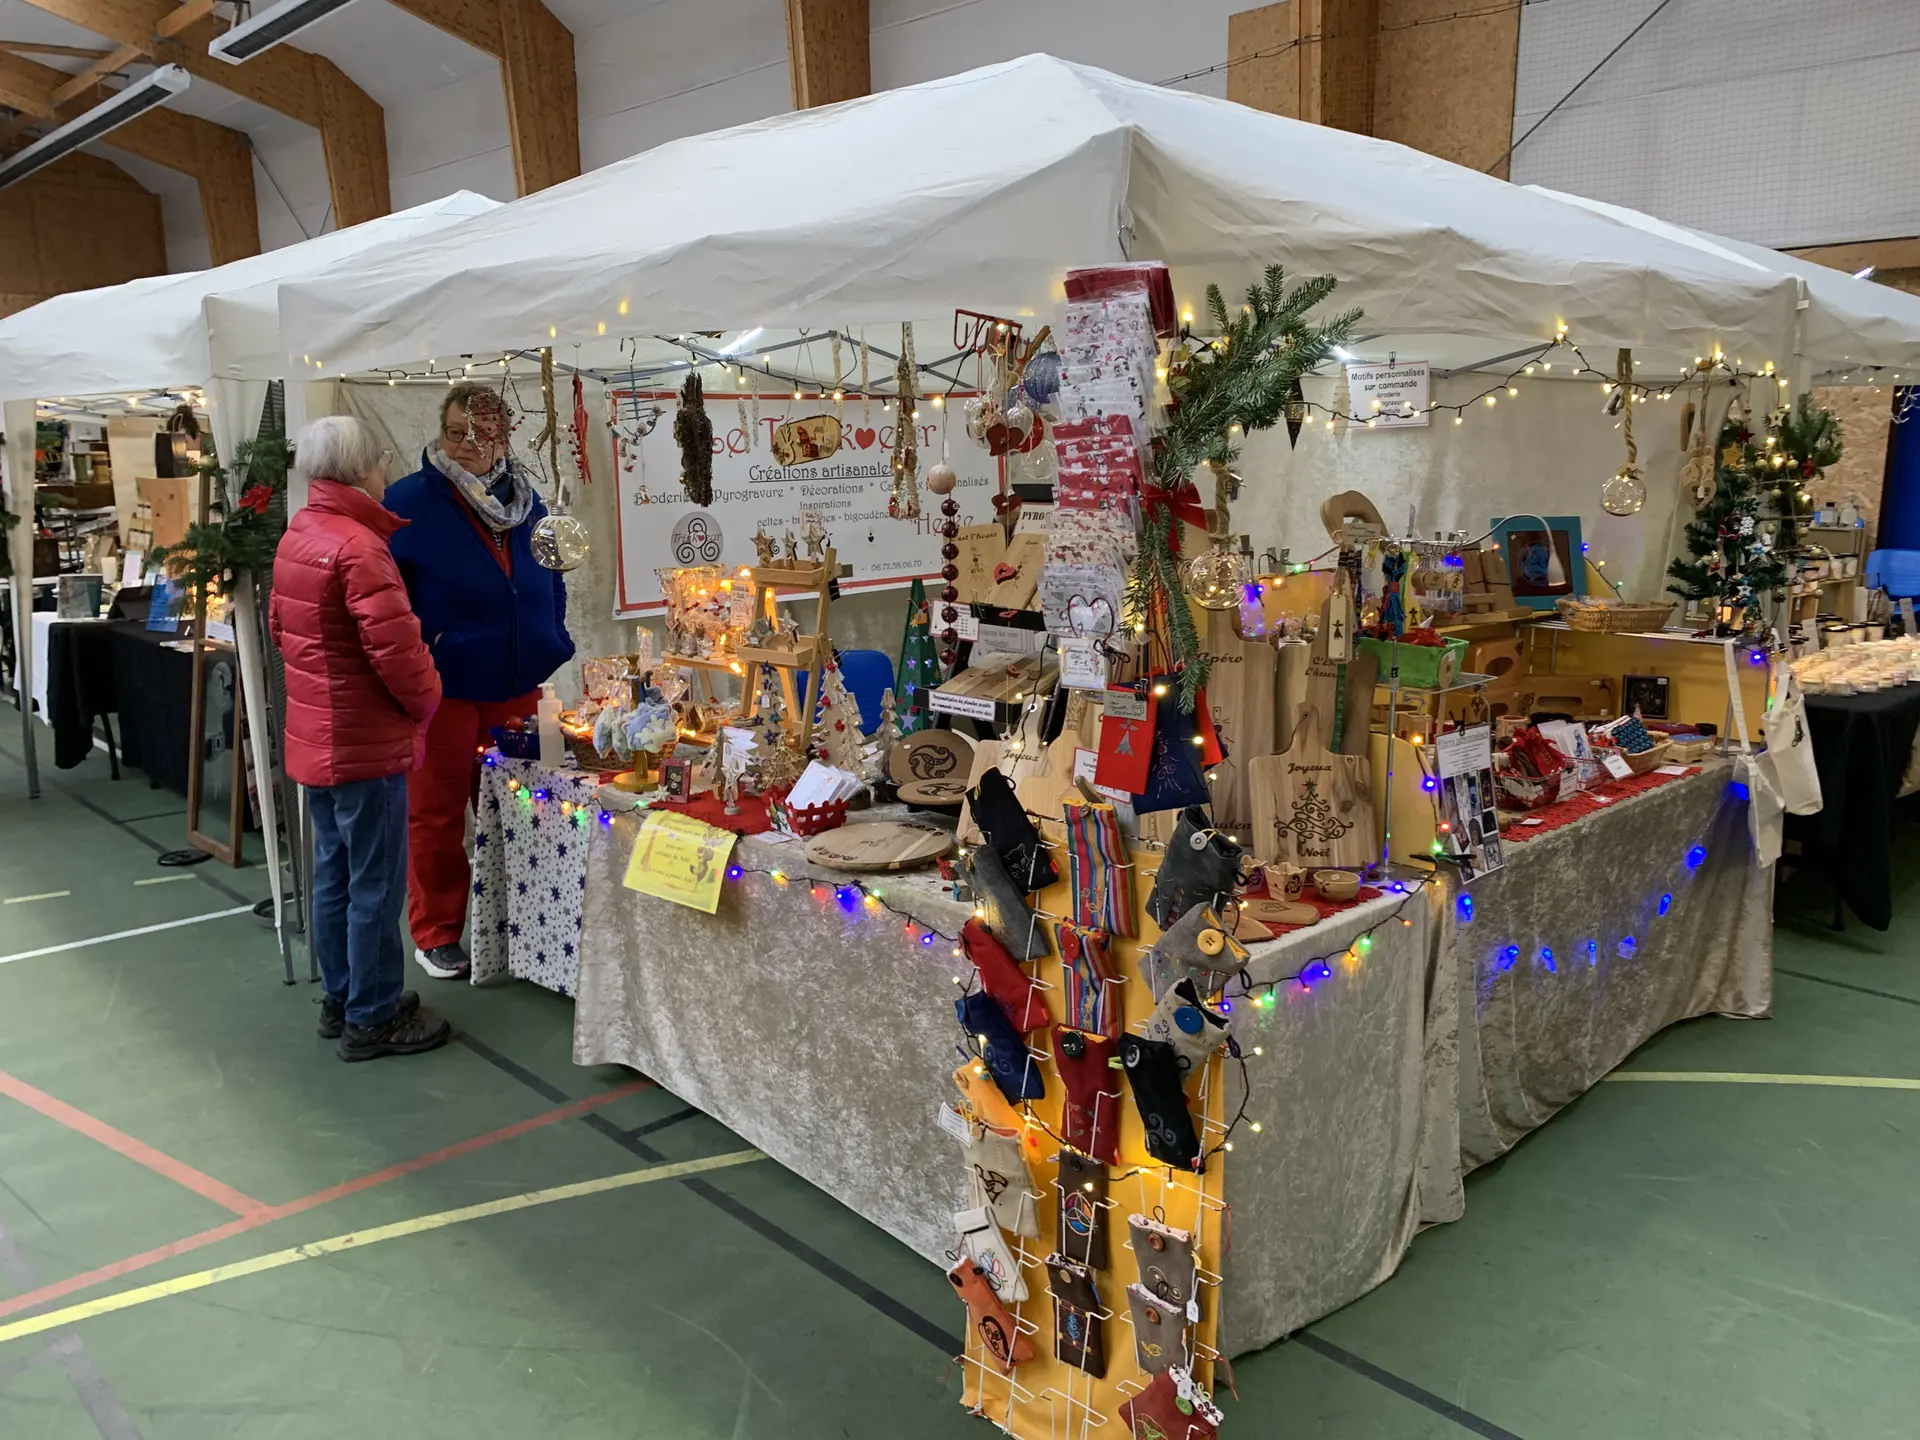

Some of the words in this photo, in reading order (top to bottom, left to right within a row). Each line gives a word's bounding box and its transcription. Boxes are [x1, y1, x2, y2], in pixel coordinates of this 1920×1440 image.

[1351, 372, 1374, 381] Motifs
[1364, 383, 1376, 391] sur
[1378, 380, 1418, 390] commande
[749, 464, 818, 481] Créations
[821, 461, 893, 477] artisanale
[800, 482, 864, 497] Décorations
[799, 500, 852, 511] Inspirations
[843, 509, 889, 523] bigoudène
[1002, 749, 1040, 763] Joyeux
[1287, 762, 1332, 775] Joyeux
[1300, 847, 1331, 858] Noël
